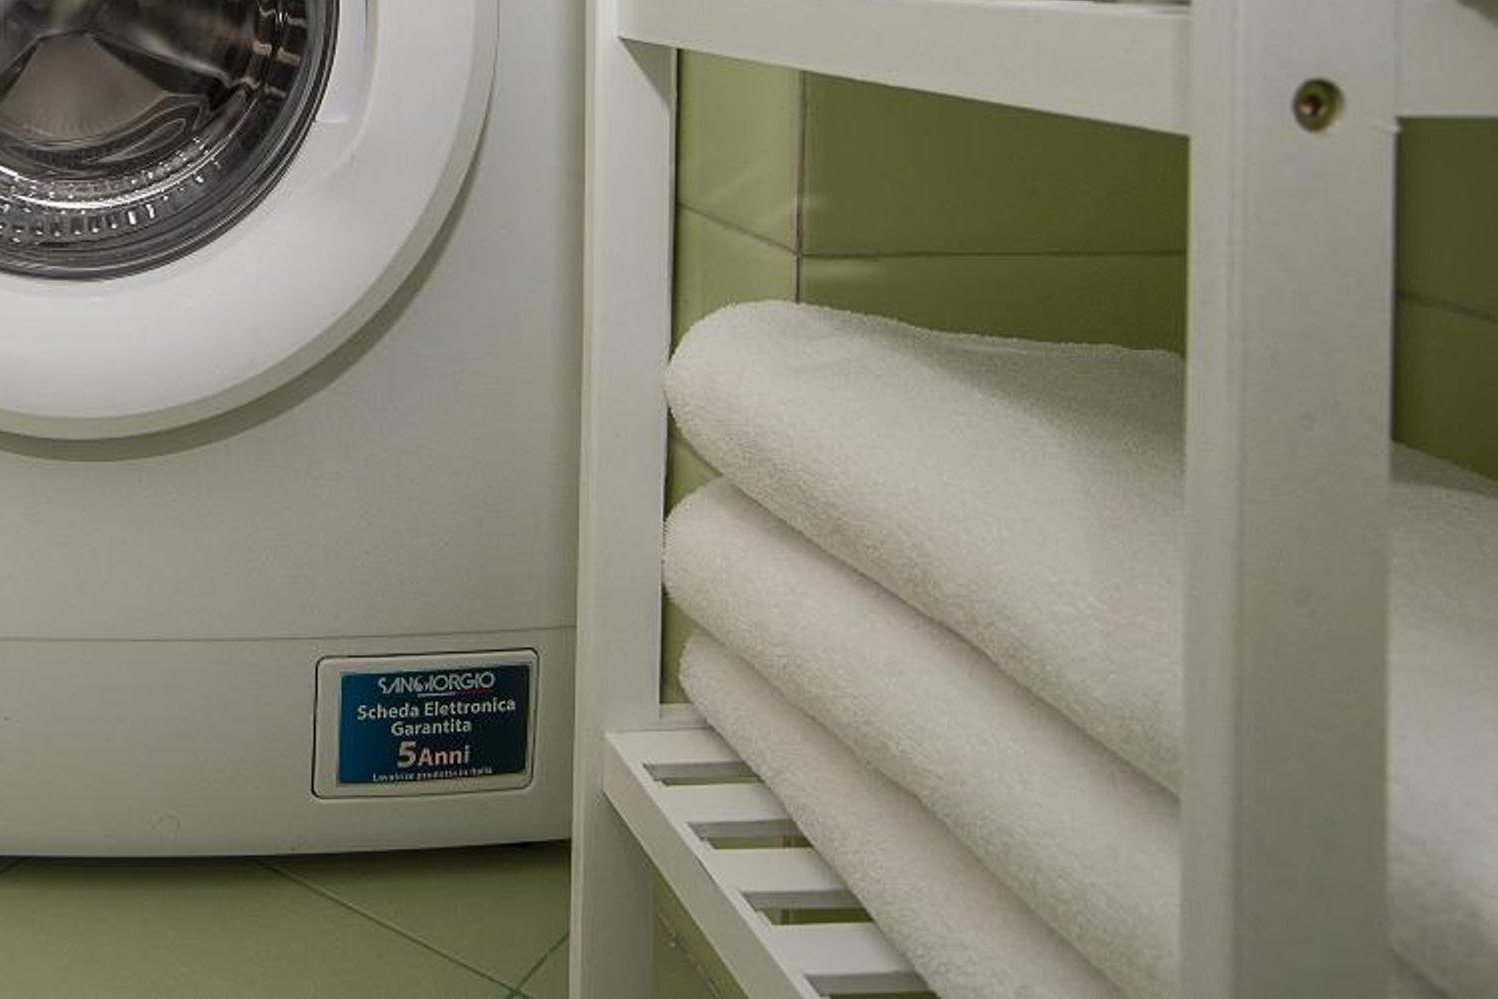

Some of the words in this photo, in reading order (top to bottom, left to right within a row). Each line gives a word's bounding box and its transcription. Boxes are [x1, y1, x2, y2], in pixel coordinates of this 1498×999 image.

[357, 702, 420, 721] Scheda
[424, 697, 517, 718] Elettronica
[391, 718, 473, 738] Garantita
[397, 741, 417, 768] 5
[418, 745, 470, 767] Anni
